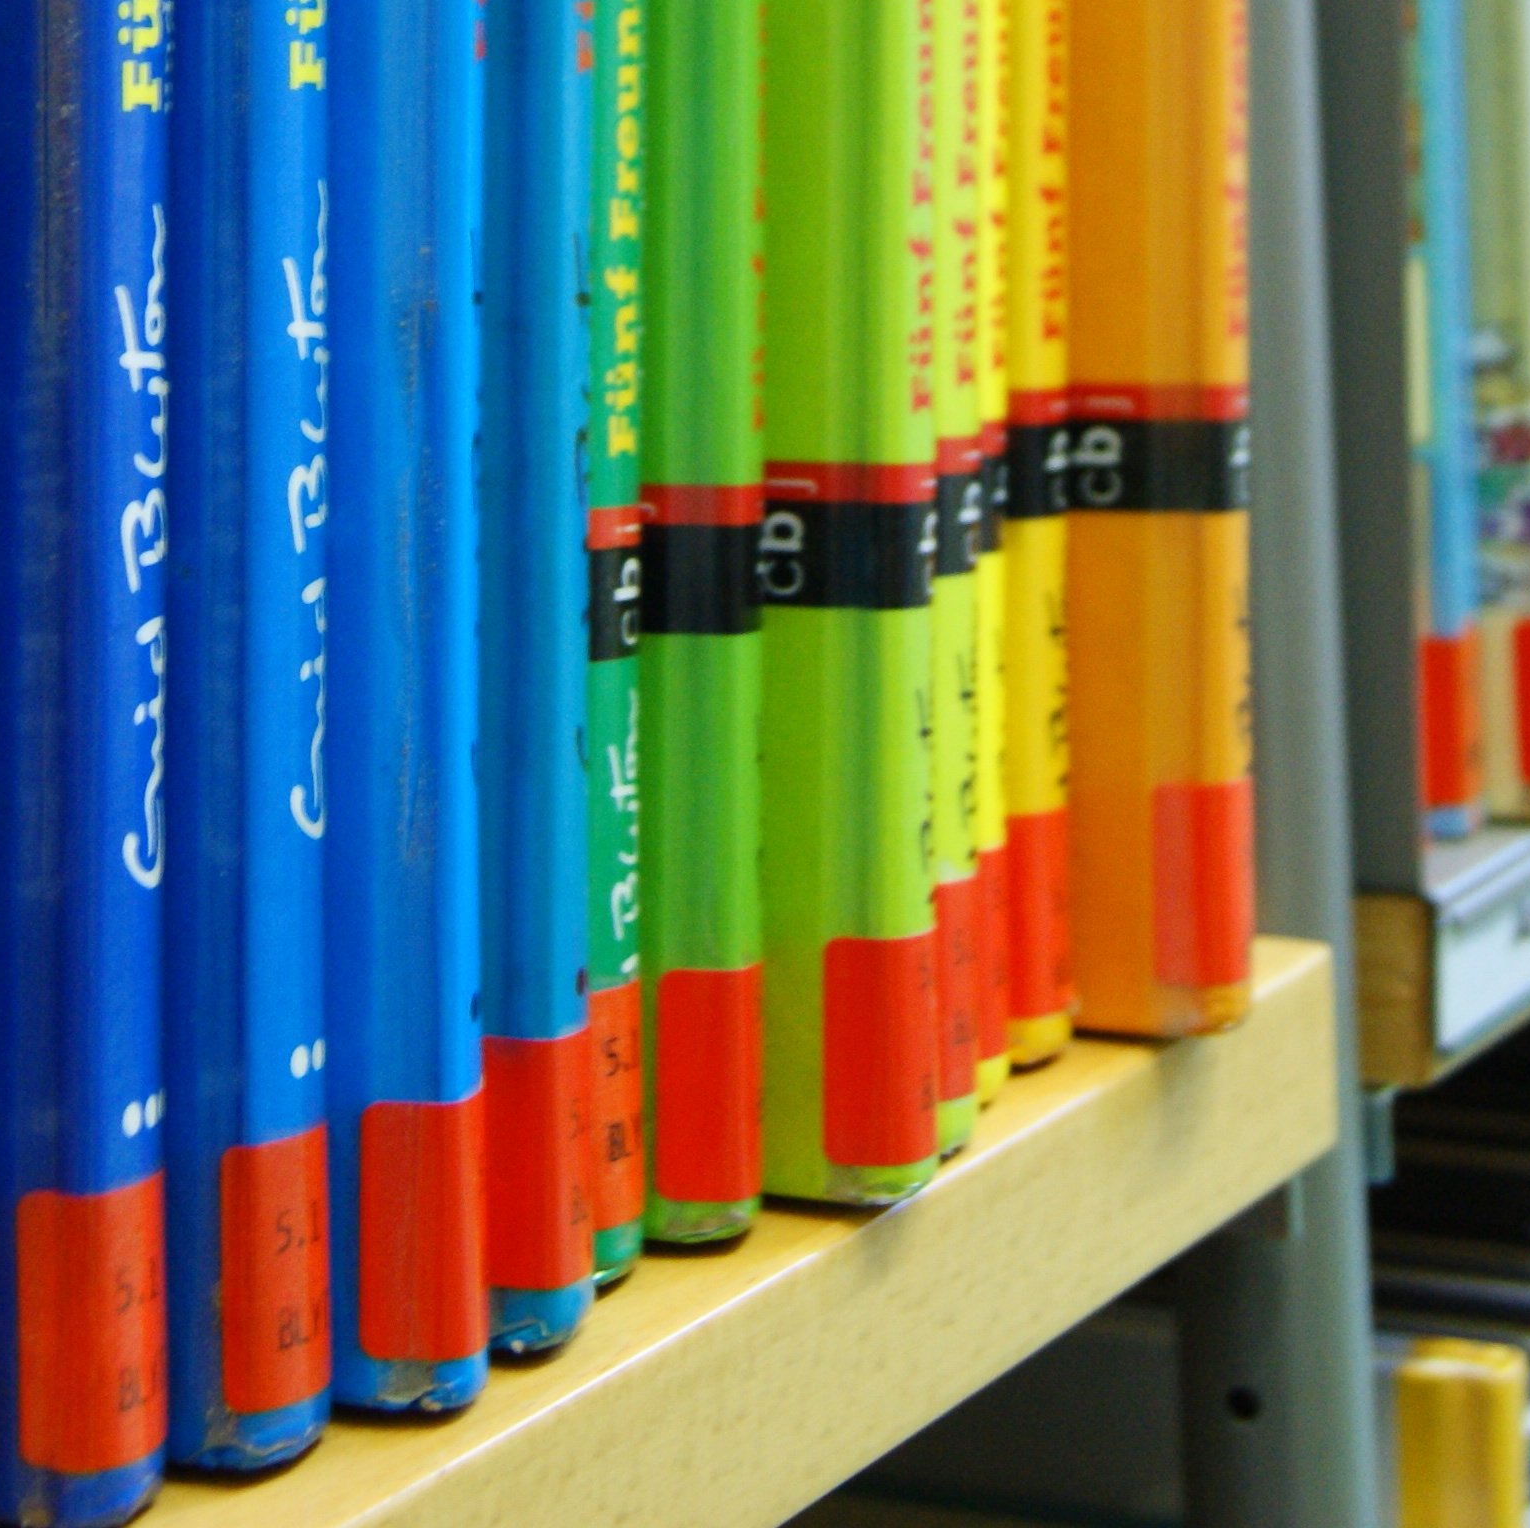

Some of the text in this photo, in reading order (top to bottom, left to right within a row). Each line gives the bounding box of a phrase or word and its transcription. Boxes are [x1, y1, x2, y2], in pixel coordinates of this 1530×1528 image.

[606, 266, 641, 458] Fünf
[123, 616, 167, 888] Enid
[290, 577, 328, 839] Enid
